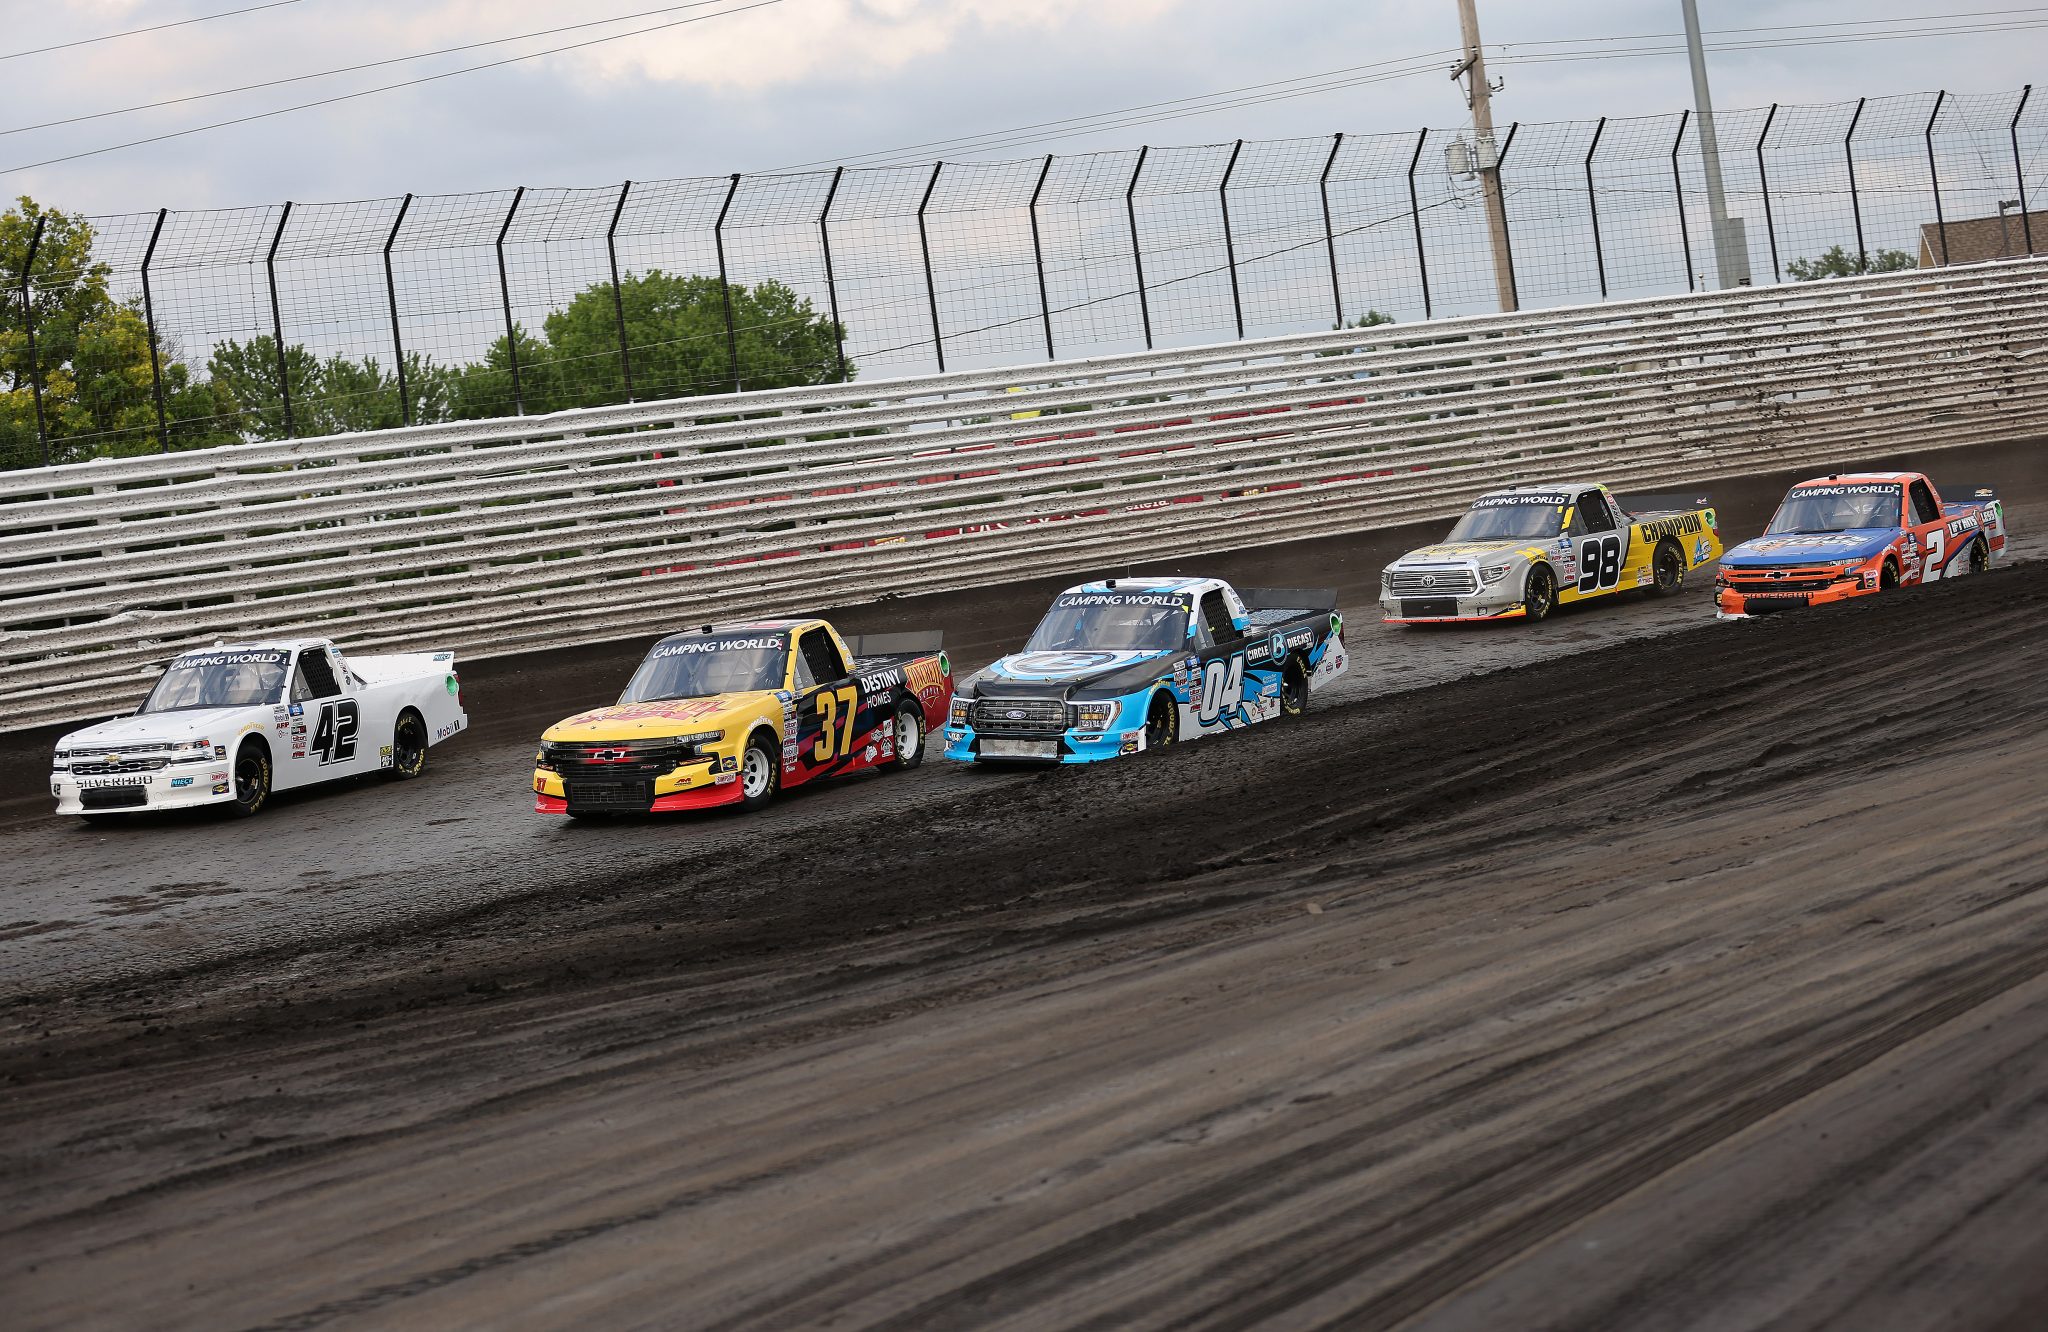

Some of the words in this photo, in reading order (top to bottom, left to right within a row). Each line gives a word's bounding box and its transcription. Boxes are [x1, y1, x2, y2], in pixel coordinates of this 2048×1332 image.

[1472, 497, 1519, 509] CAMPING
[1520, 496, 1565, 504] WORLD
[1792, 487, 1845, 498] CAMPING
[1847, 485, 1894, 494] WORLD
[1641, 513, 1703, 543] CHAMPION
[1578, 534, 1621, 594] 98
[1921, 527, 1946, 584] 2
[1059, 596, 1122, 607] CAMPING
[1124, 596, 1184, 606] WORLD
[652, 641, 717, 659] CAMPING
[718, 638, 780, 651] WORLD
[1247, 645, 1270, 660] CIRCLE
[1287, 631, 1312, 648] DIECAST
[170, 655, 226, 671] CAMPING
[227, 653, 280, 664] WORLD
[860, 669, 900, 693] DESTINY
[1199, 652, 1244, 724] 04
[866, 691, 892, 708] HOMES
[308, 698, 360, 767] 42
[437, 723, 454, 739] Mobil
[815, 685, 857, 761] 37
